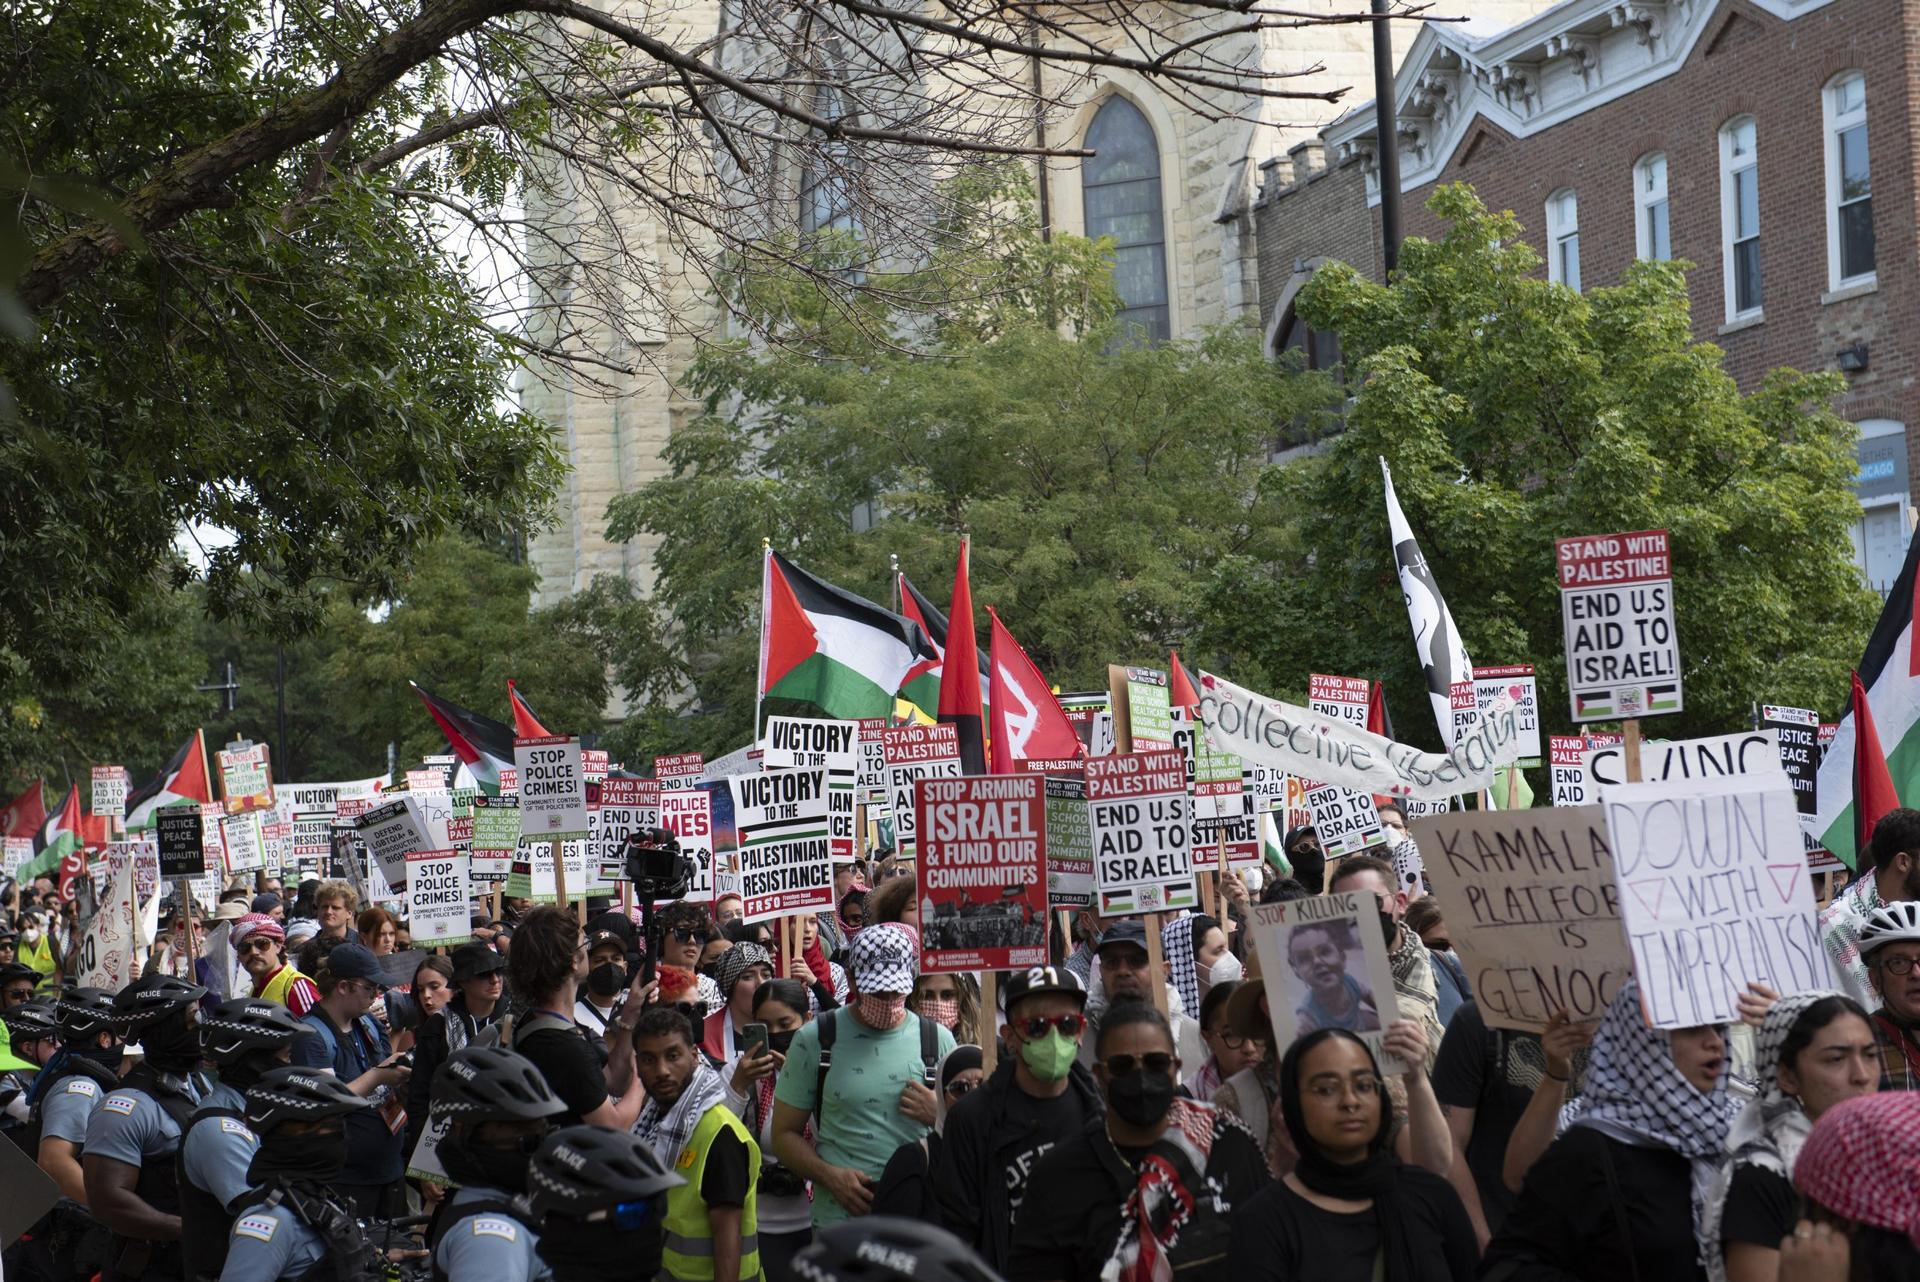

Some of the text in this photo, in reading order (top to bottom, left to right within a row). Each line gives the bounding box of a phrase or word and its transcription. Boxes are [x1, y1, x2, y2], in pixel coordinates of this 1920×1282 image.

[1864, 462, 1894, 479] ICAGO
[1560, 535, 1666, 561] STAND WITH
[1562, 556, 1667, 584] PALESTINE!
[1570, 588, 1665, 620] END U.S
[1574, 617, 1669, 652] AID TO
[1576, 649, 1673, 684] ISRAEL!
[1312, 677, 1367, 691] STAND WITH
[1312, 688, 1367, 703] PALESTINE!
[1313, 703, 1364, 720] END U.S
[1454, 712, 1477, 726] END
[1782, 714, 1807, 722] PALESTINE!
[863, 720, 885, 729] WITH
[773, 721, 853, 753] VICTORY
[885, 727, 956, 744] STAND WITH
[864, 744, 883, 756] U.S
[887, 742, 958, 761] PALESTINE!
[1552, 739, 1582, 750] STAND
[530, 750, 565, 764] STOP
[656, 755, 701, 766] STAND WITH
[793, 753, 826, 766] TO THE
[866, 758, 884, 771] TO
[1028, 760, 1083, 770] FREE PALESTINE
[235, 762, 250, 772] FOR
[526, 765, 573, 780] POLICE
[582, 763, 607, 772] STINE!
[657, 764, 702, 776] PALESTINE!
[1087, 754, 1181, 777] STAND WITH
[1786, 766, 1800, 774] AND
[1556, 769, 1582, 783] END
[524, 780, 577, 796] CRIMES!
[602, 781, 659, 792] STAND WITH
[661, 779, 681, 790] END
[740, 770, 823, 809] VICTORY
[924, 778, 1036, 802] STOP ARMING
[1090, 771, 1184, 798] PALESTINE!
[1196, 782, 1242, 795] NOT WAR!
[294, 788, 338, 804] VICTORY
[602, 793, 659, 804] PALESTINE!
[1310, 788, 1338, 806] END
[1557, 786, 1584, 801] AID
[663, 797, 706, 812] POLICE
[764, 803, 798, 821] TO THE
[1316, 795, 1370, 823] AID TO
[1407, 802, 1446, 814] AID TO
[604, 810, 655, 824] END U.S
[925, 801, 1038, 842] ISRAEL
[1096, 800, 1182, 829] END U.S
[160, 820, 197, 830] JUSTICE.
[374, 824, 403, 838] DEFEND
[663, 813, 708, 837] MES
[1319, 811, 1376, 839] ISRAEL!
[164, 832, 194, 842] PEACE.
[1100, 825, 1185, 856] AID TO
[1610, 792, 1767, 877] DOWN
[375, 836, 421, 857] REPRODUCTIVE
[926, 840, 1037, 866] & FUND OUR
[1436, 826, 1612, 877] KAMALA
[162, 851, 199, 861] EQUALITY!
[741, 839, 828, 871] PALESTINIAN
[420, 863, 452, 876] STOP
[1062, 861, 1089, 872] WAR!
[1101, 852, 1188, 883] ISRAEL!
[416, 876, 459, 891] POLICE
[743, 864, 830, 897] RESISTANCE
[927, 865, 1038, 889] COMMUNITIES
[414, 890, 462, 905] CRIMES!
[1670, 865, 1764, 920] WITH
[748, 896, 781, 914] FRSO
[1255, 894, 1358, 926] STOP KILLING
[1466, 884, 1620, 923] PLATFOR
[1558, 923, 1587, 949] IS
[1010, 949, 1034, 959] SUMMER
[1028, 966, 1059, 989] 21
[136, 990, 161, 1000] POLICE
[1479, 965, 1611, 1024] GENOC
[21, 1010, 41, 1019] POLICE
[245, 1006, 272, 1017] POLICE
[450, 1061, 476, 1081] POLICE
[288, 1075, 319, 1090] POLICE
[552, 1144, 587, 1170] POLICE
[856, 1241, 918, 1276] POLICE
